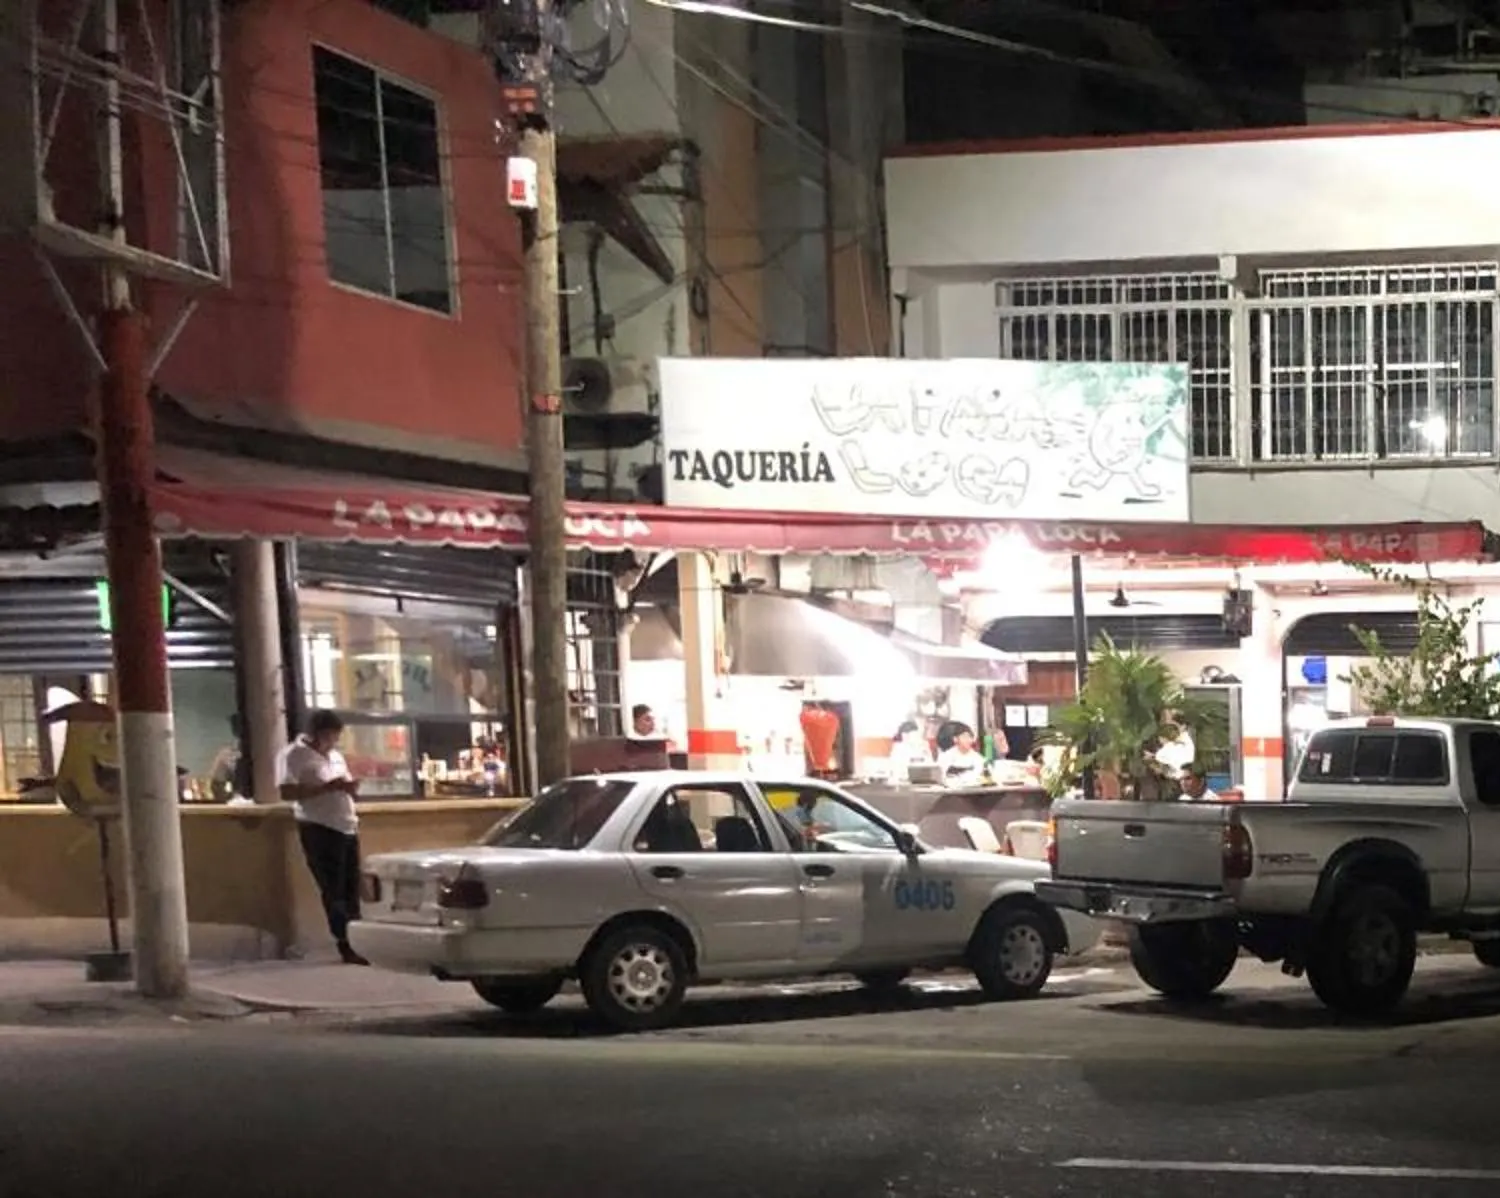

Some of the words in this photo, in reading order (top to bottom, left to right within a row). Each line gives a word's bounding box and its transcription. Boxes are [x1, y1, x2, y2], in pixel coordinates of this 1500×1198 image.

[668, 441, 836, 489] TAQUERÍA
[563, 510, 651, 538] OCA
[891, 520, 935, 543] LA
[1034, 523, 1122, 544] LOCA
